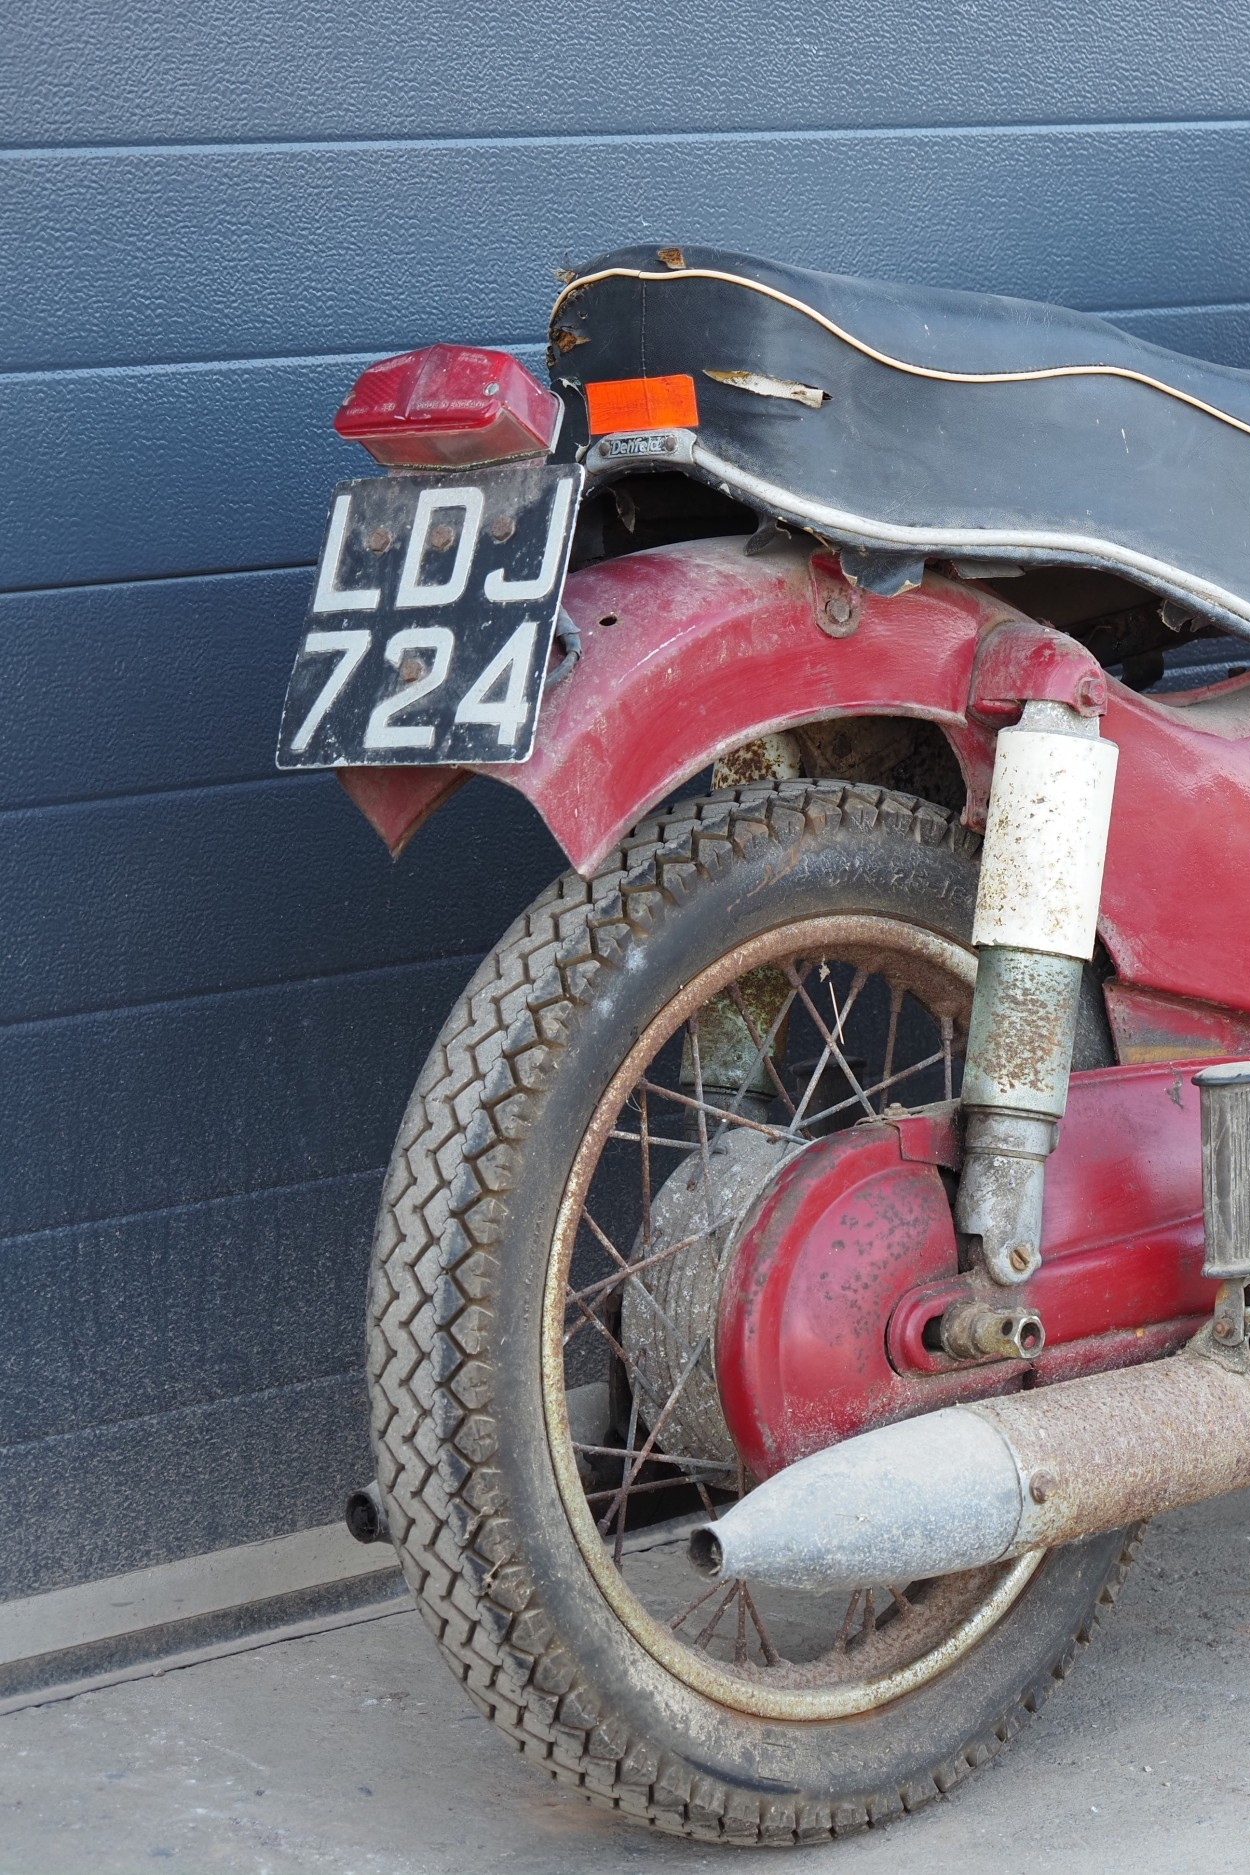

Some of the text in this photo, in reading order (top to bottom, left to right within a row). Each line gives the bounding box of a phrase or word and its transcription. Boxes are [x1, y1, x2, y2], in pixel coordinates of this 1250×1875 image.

[610, 435, 664, 456] Denfeld
[313, 478, 574, 613] LDJ
[291, 621, 541, 752] 724
